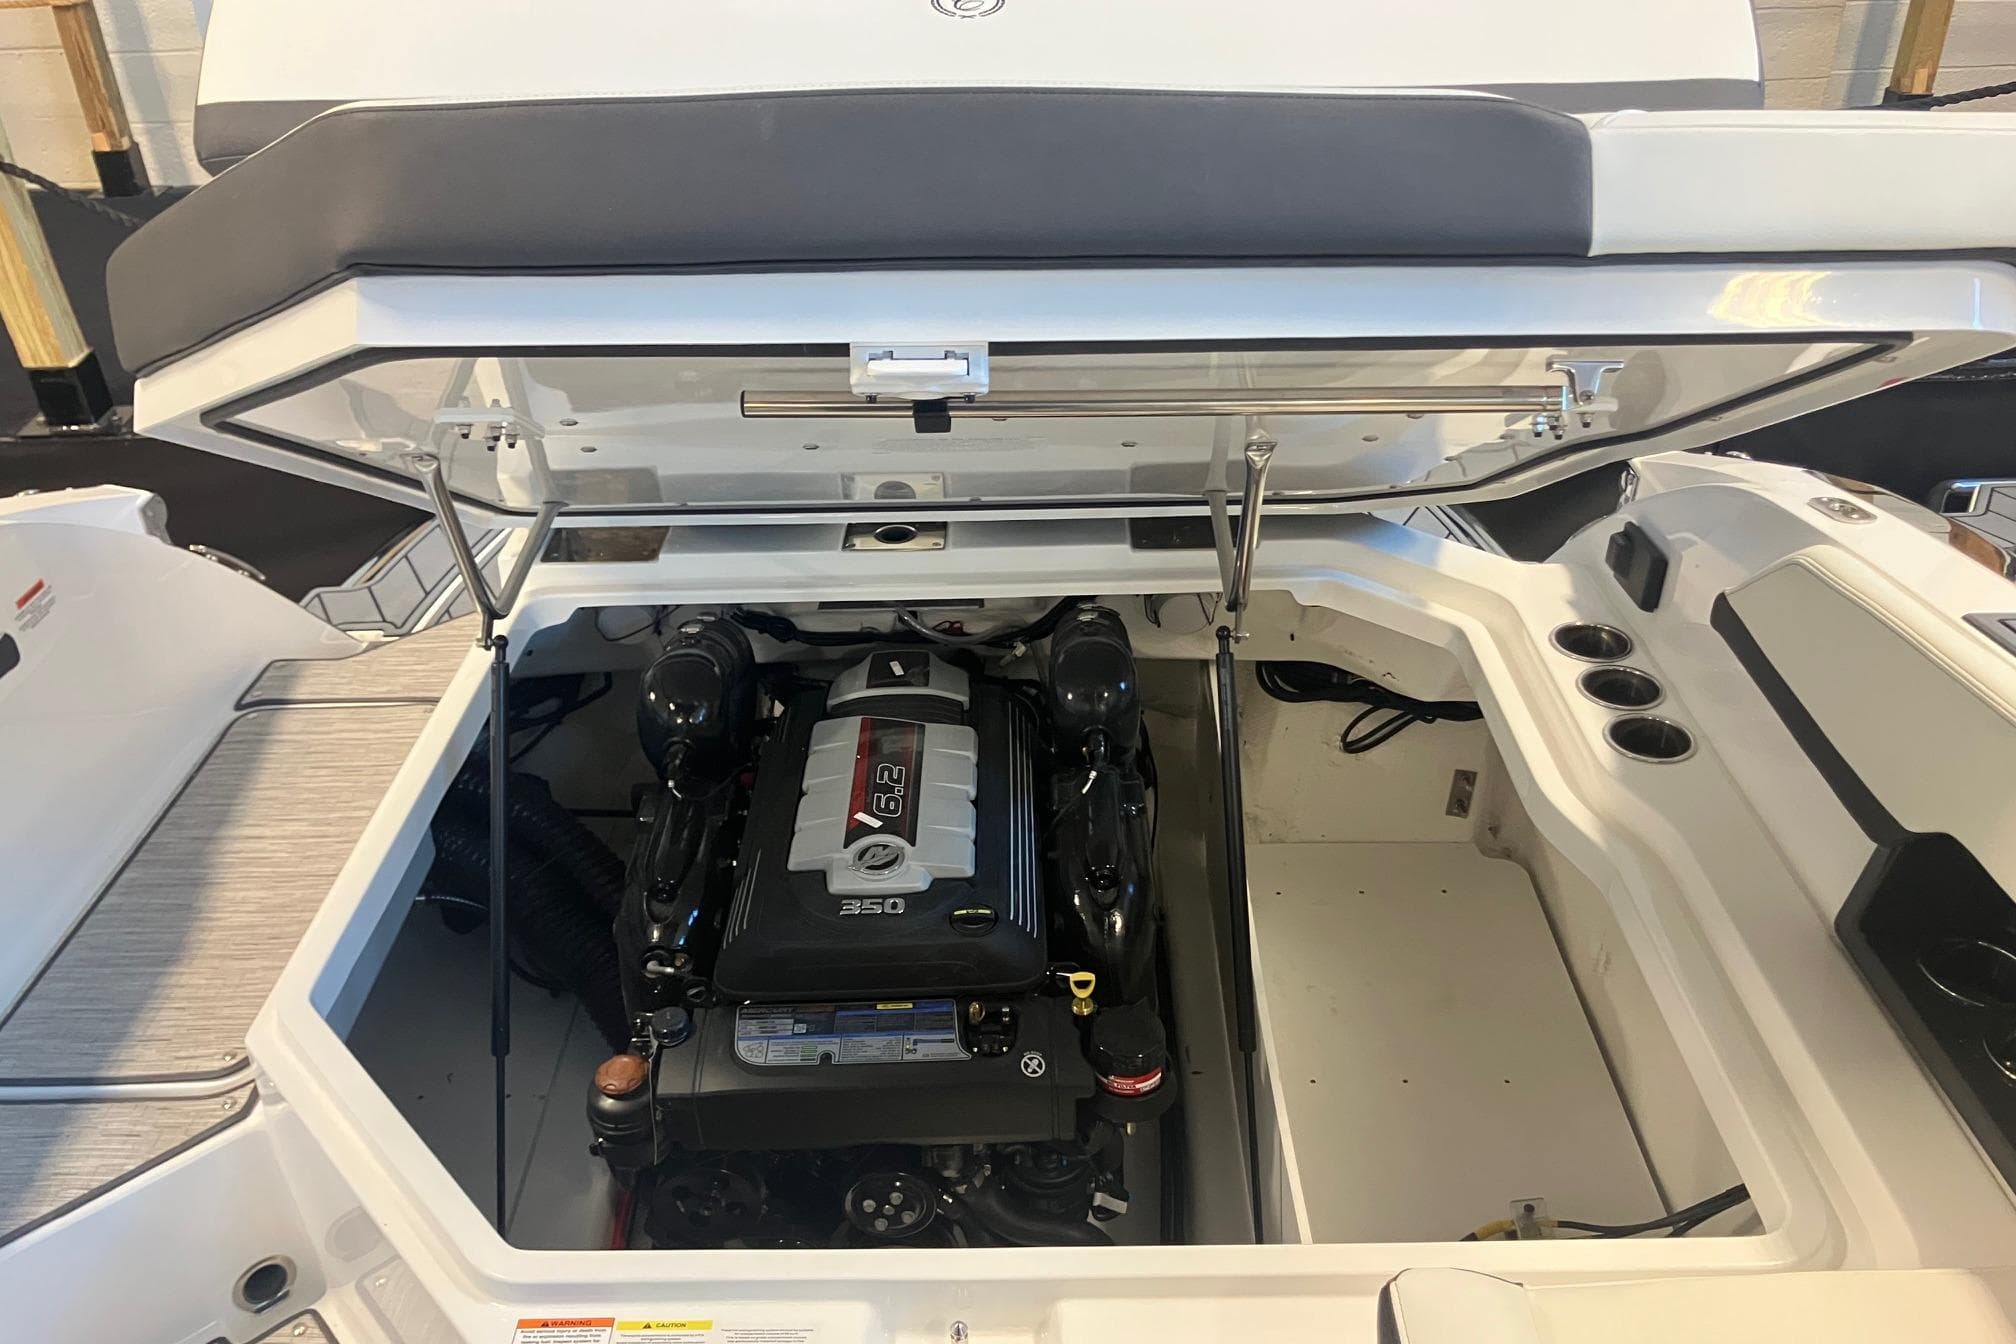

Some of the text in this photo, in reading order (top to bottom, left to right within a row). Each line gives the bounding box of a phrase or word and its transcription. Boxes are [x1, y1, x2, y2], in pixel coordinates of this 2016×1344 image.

[873, 763, 906, 818] 6.2
[839, 897, 906, 916] 350
[551, 1319, 592, 1327] WARNING
